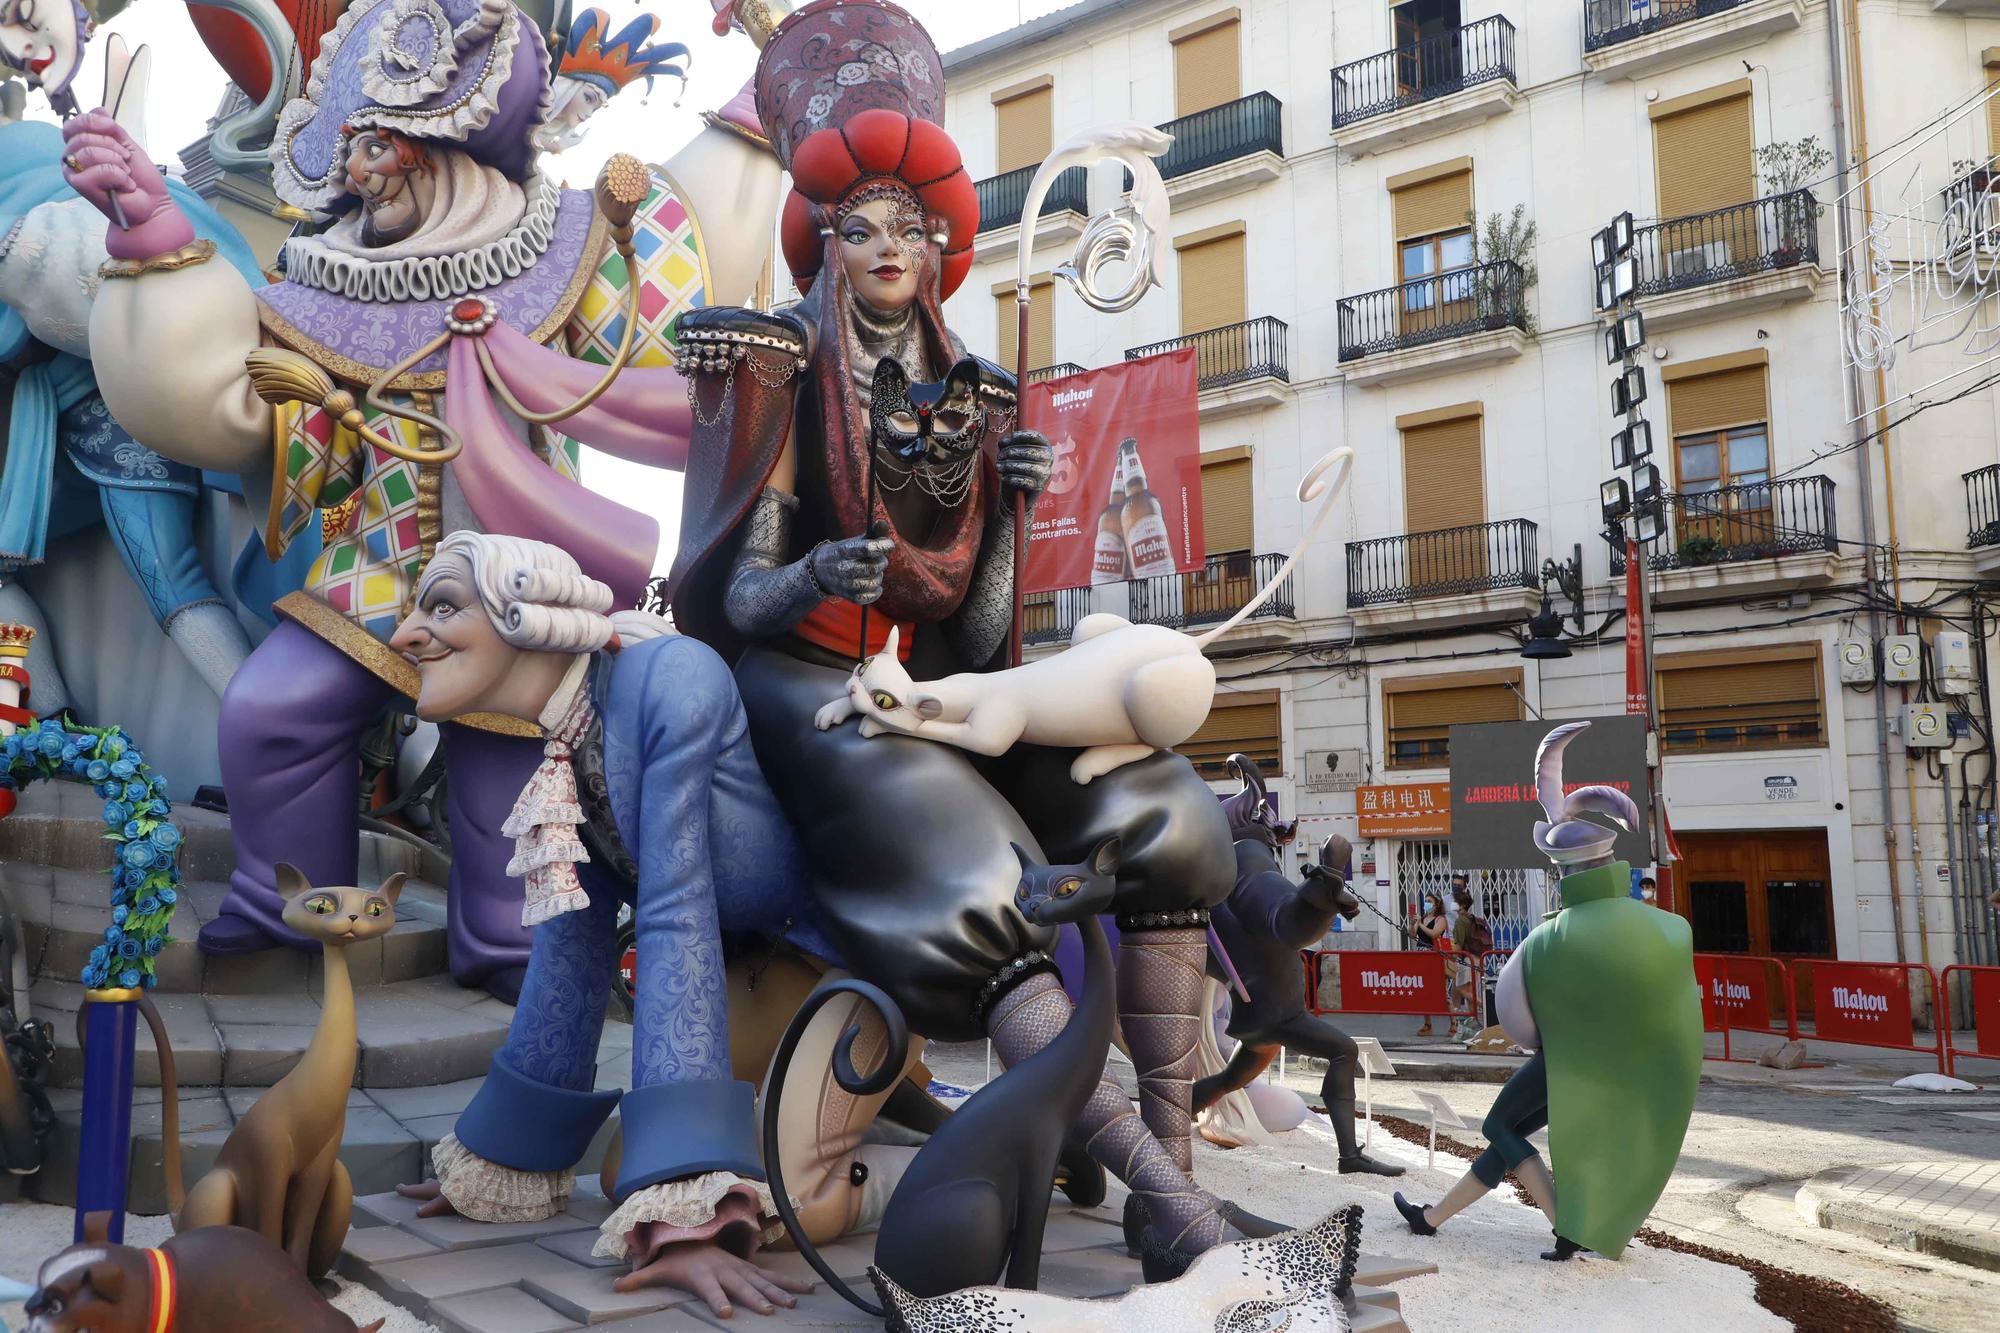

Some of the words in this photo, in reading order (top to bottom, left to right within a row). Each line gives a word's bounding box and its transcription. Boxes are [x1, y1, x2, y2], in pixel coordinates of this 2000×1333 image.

[1052, 388, 1093, 407] Mahou
[1032, 521, 1050, 530] stas
[1051, 517, 1077, 527] Fallas
[1030, 527, 1082, 541] contrarnos.
[1362, 789, 1434, 810] 盈科电讯
[1465, 783, 1520, 804] ¿ARDERÁ
[1360, 970, 1424, 988] Mahou
[1832, 986, 1888, 1012] Mahou
